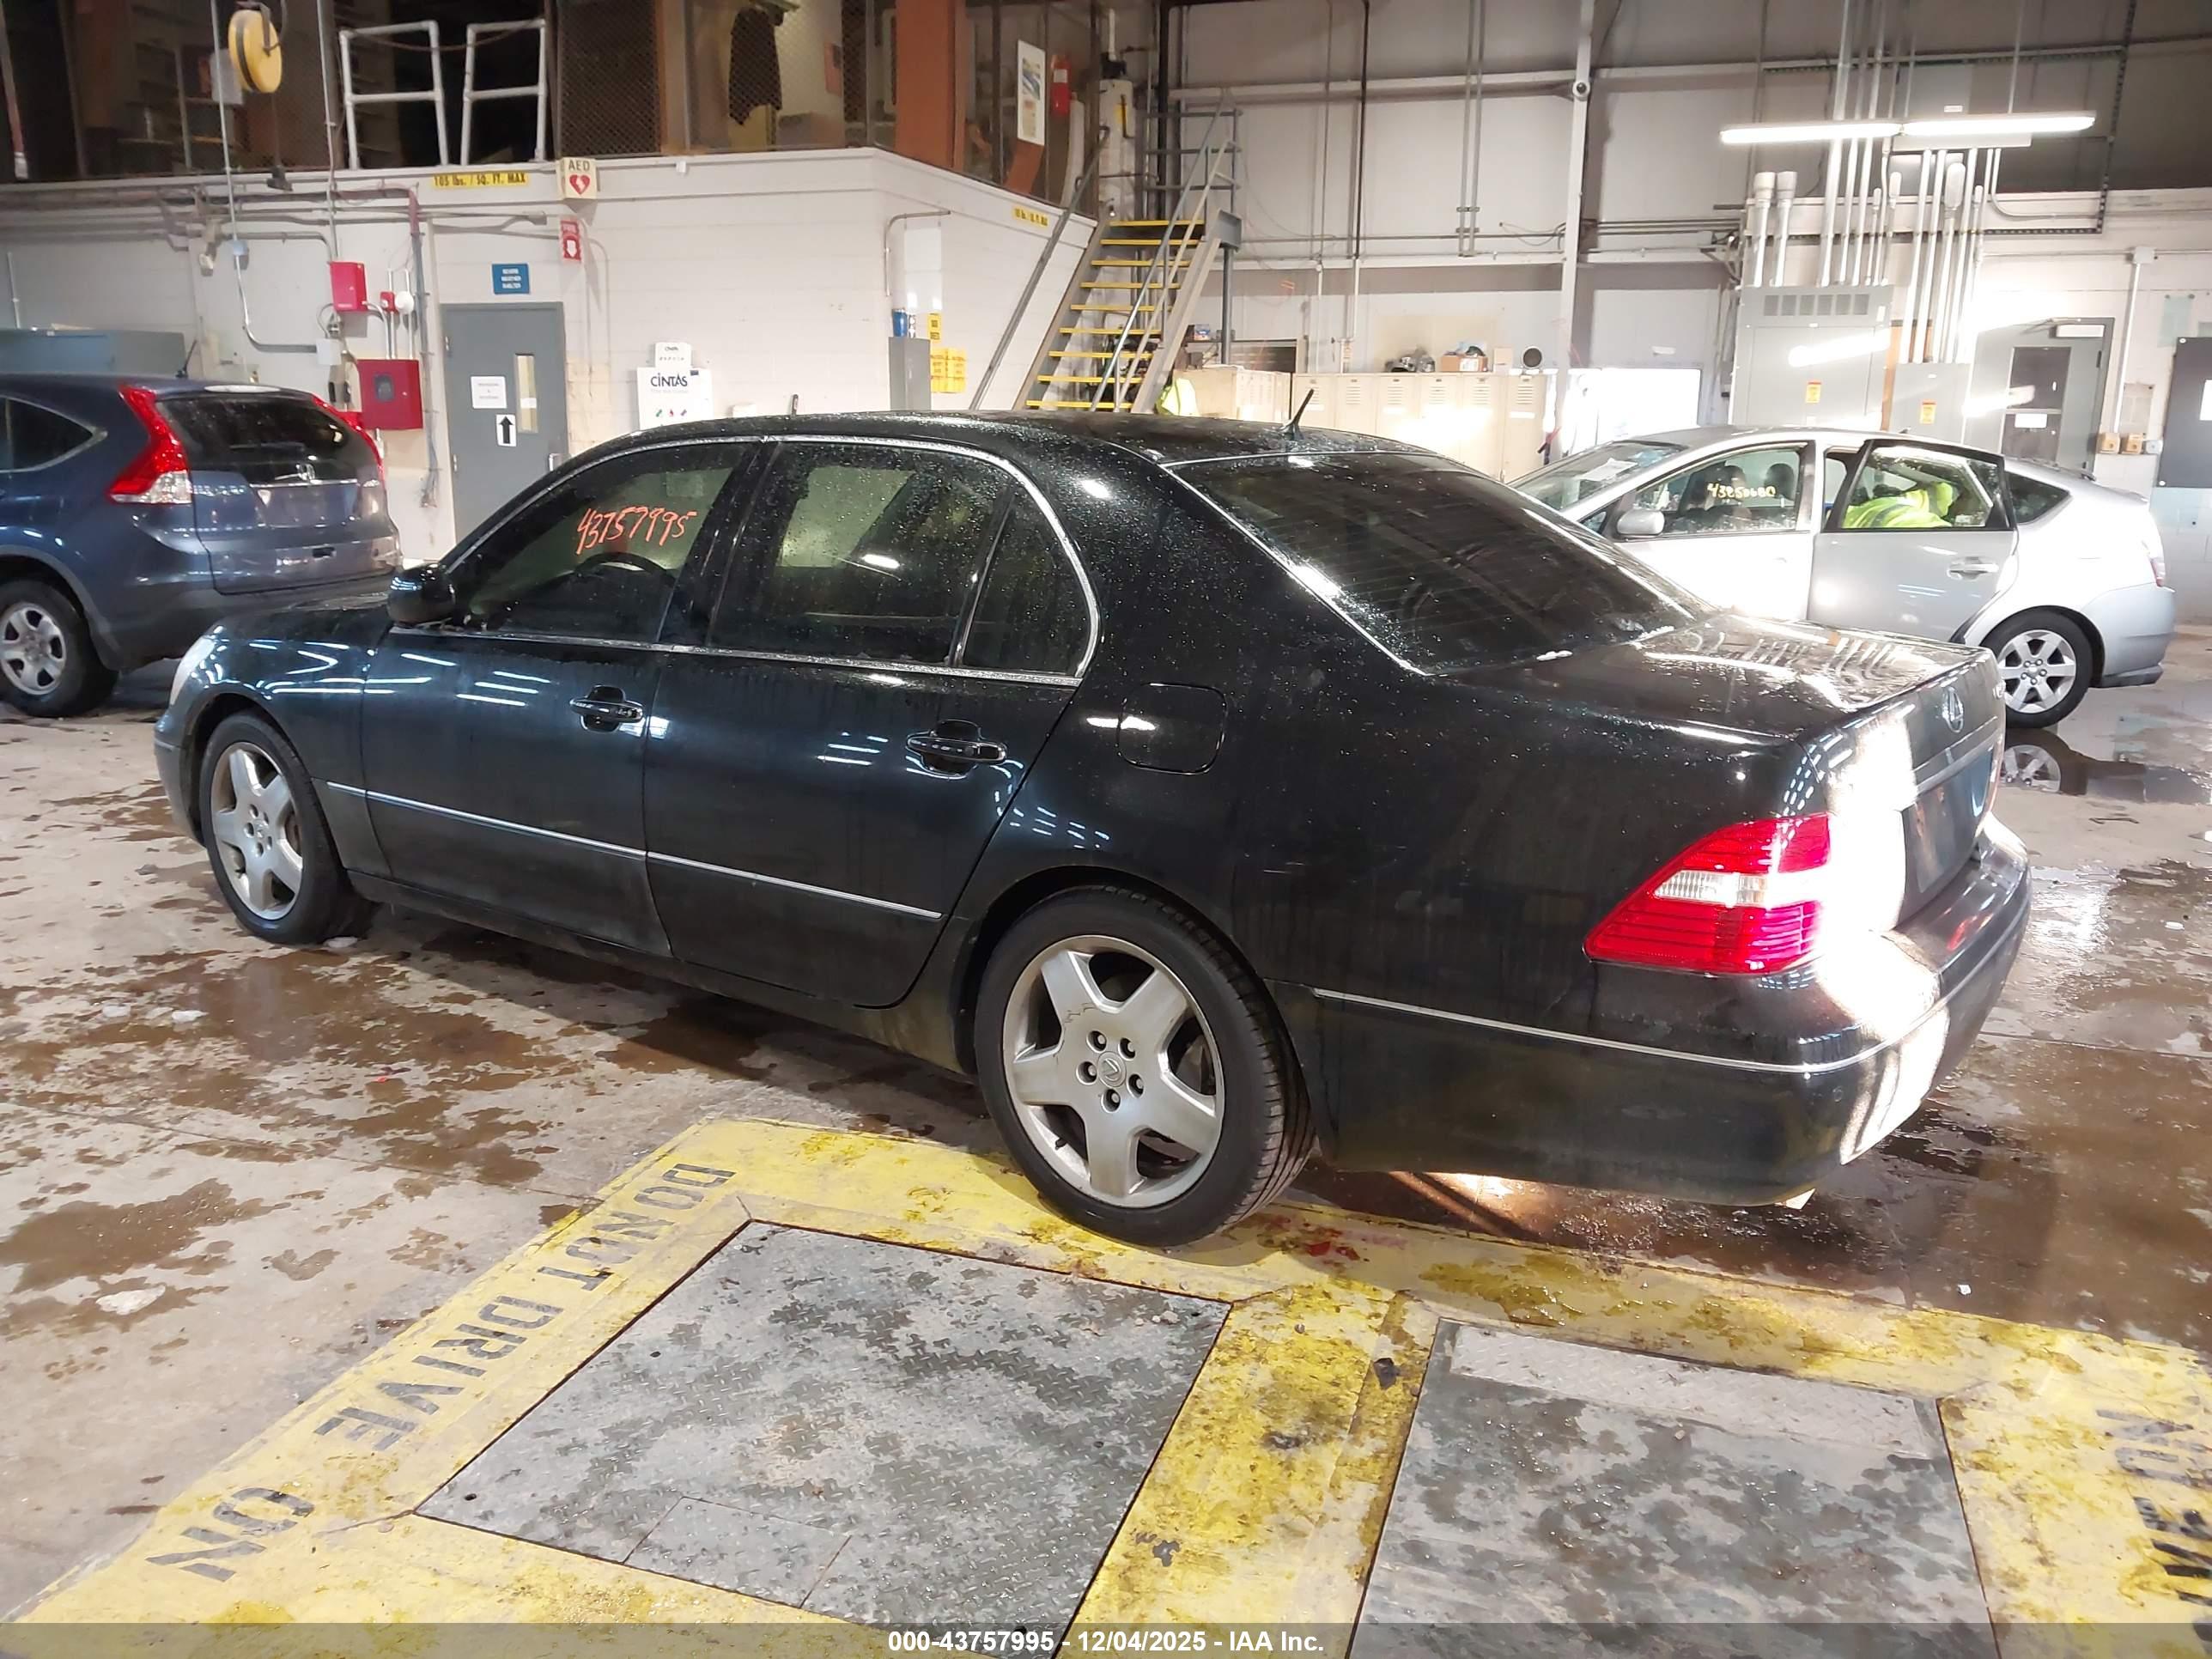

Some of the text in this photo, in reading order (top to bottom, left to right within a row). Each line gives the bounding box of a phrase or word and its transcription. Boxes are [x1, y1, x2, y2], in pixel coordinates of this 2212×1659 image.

[507, 171, 526, 184] MAX
[568, 159, 591, 171] AED
[575, 506, 698, 556] 43757995
[313, 1295, 565, 1451] DRIVE
[144, 1486, 316, 1583] ON
